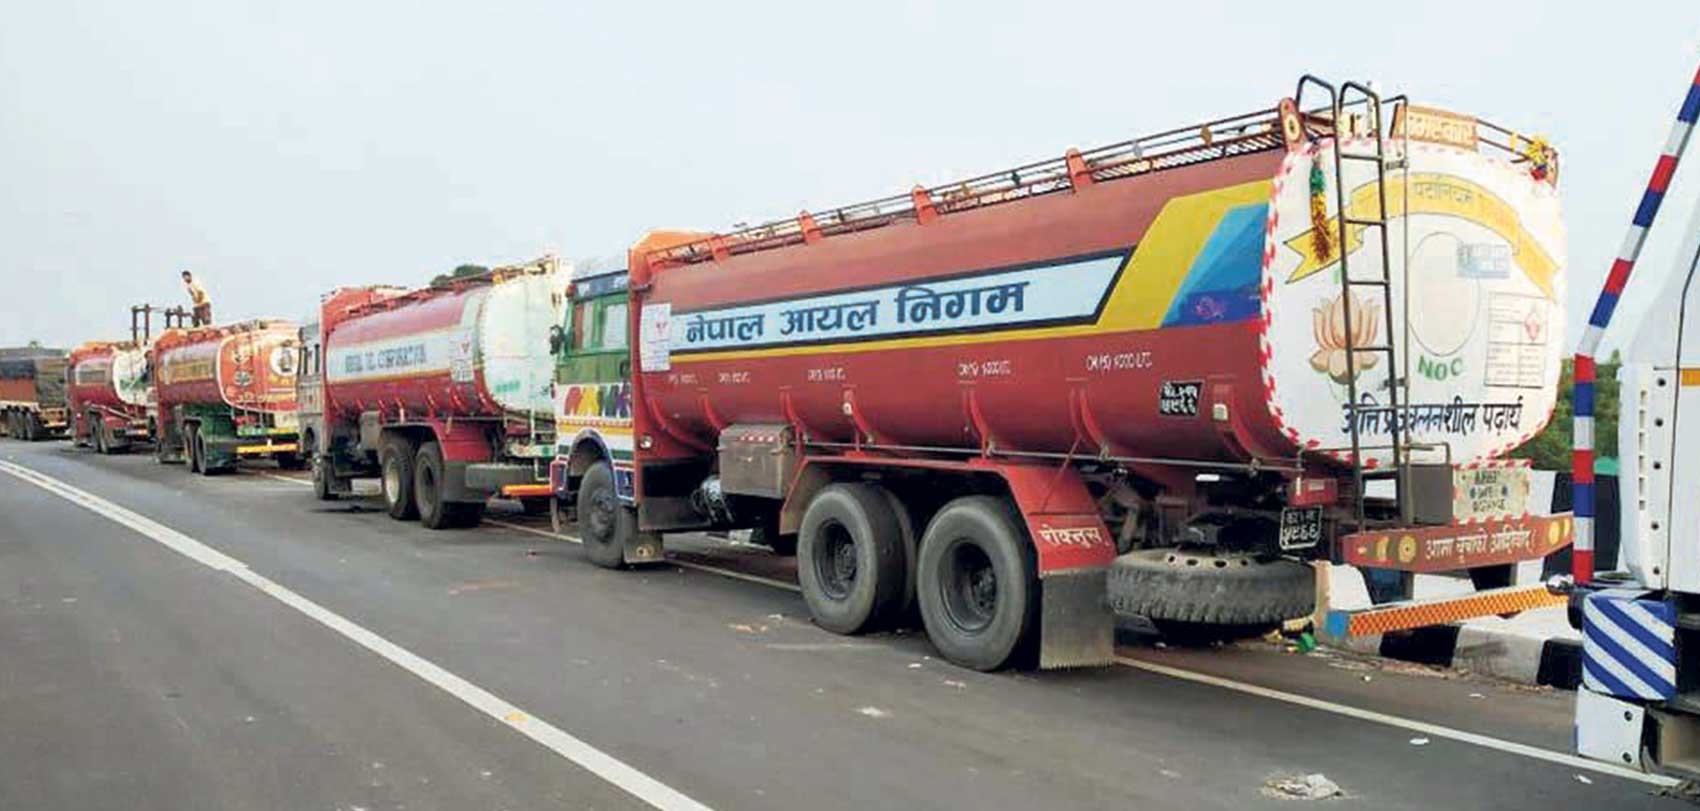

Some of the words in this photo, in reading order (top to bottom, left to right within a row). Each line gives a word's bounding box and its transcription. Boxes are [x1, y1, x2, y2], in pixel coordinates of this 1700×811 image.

[685, 313, 766, 343] नेपाल
[780, 300, 880, 336] आयल
[894, 281, 1031, 325] निगम
[1418, 355, 1463, 381] NOC
